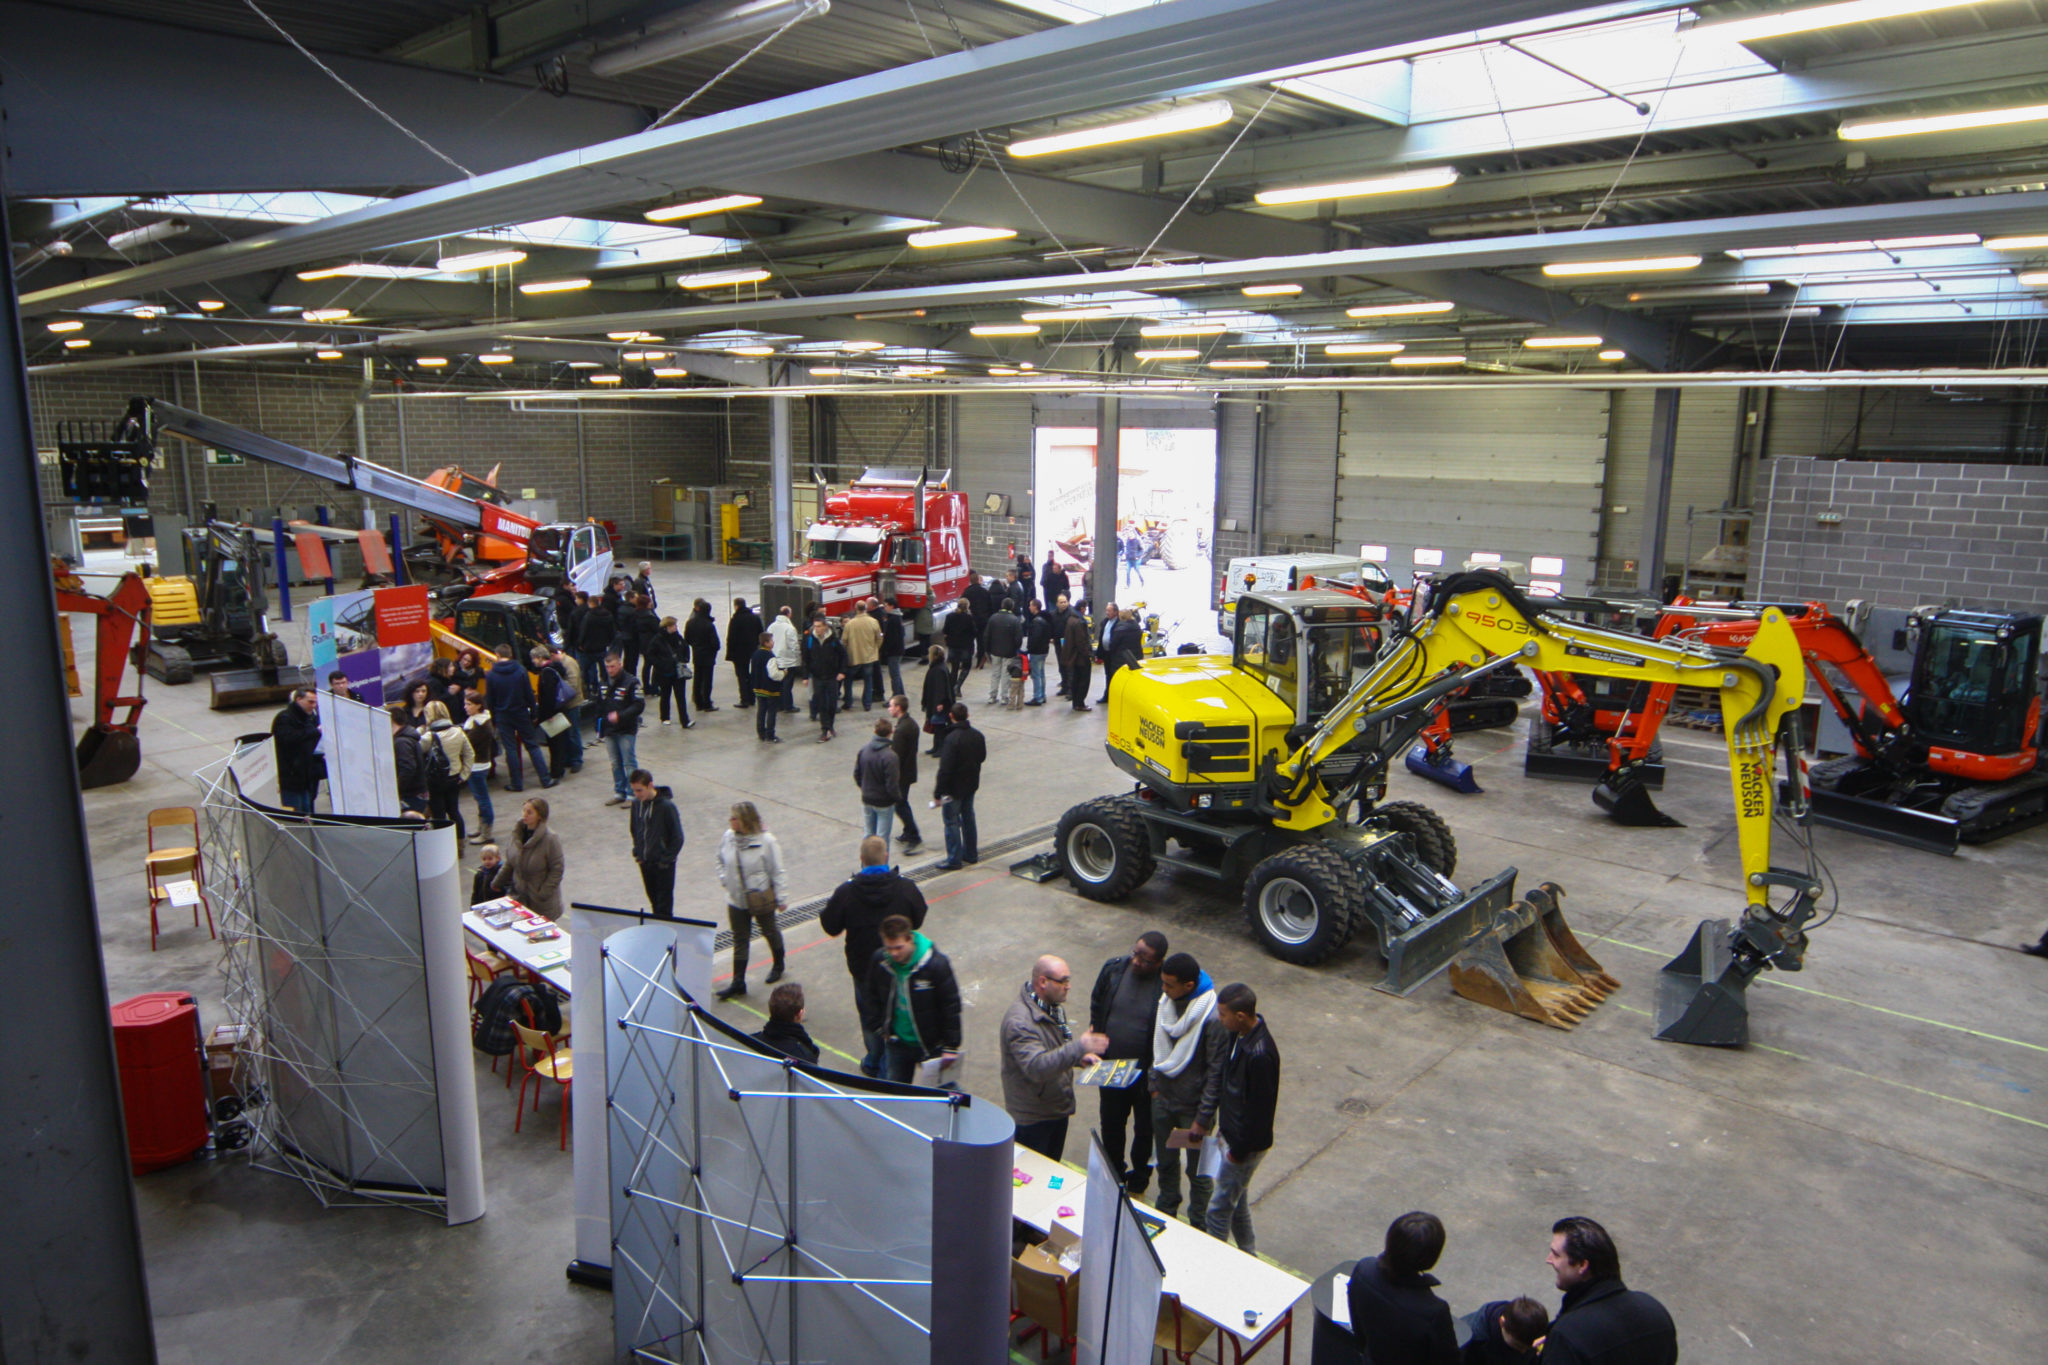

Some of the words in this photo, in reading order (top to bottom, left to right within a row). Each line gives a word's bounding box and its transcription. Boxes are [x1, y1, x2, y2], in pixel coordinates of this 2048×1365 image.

[497, 517, 531, 539] MANITOU
[1139, 715, 1164, 737] WACKER
[1139, 726, 1164, 748] NEUSON
[1740, 763, 1753, 817] NEUSON
[1752, 760, 1765, 816] WACKER
